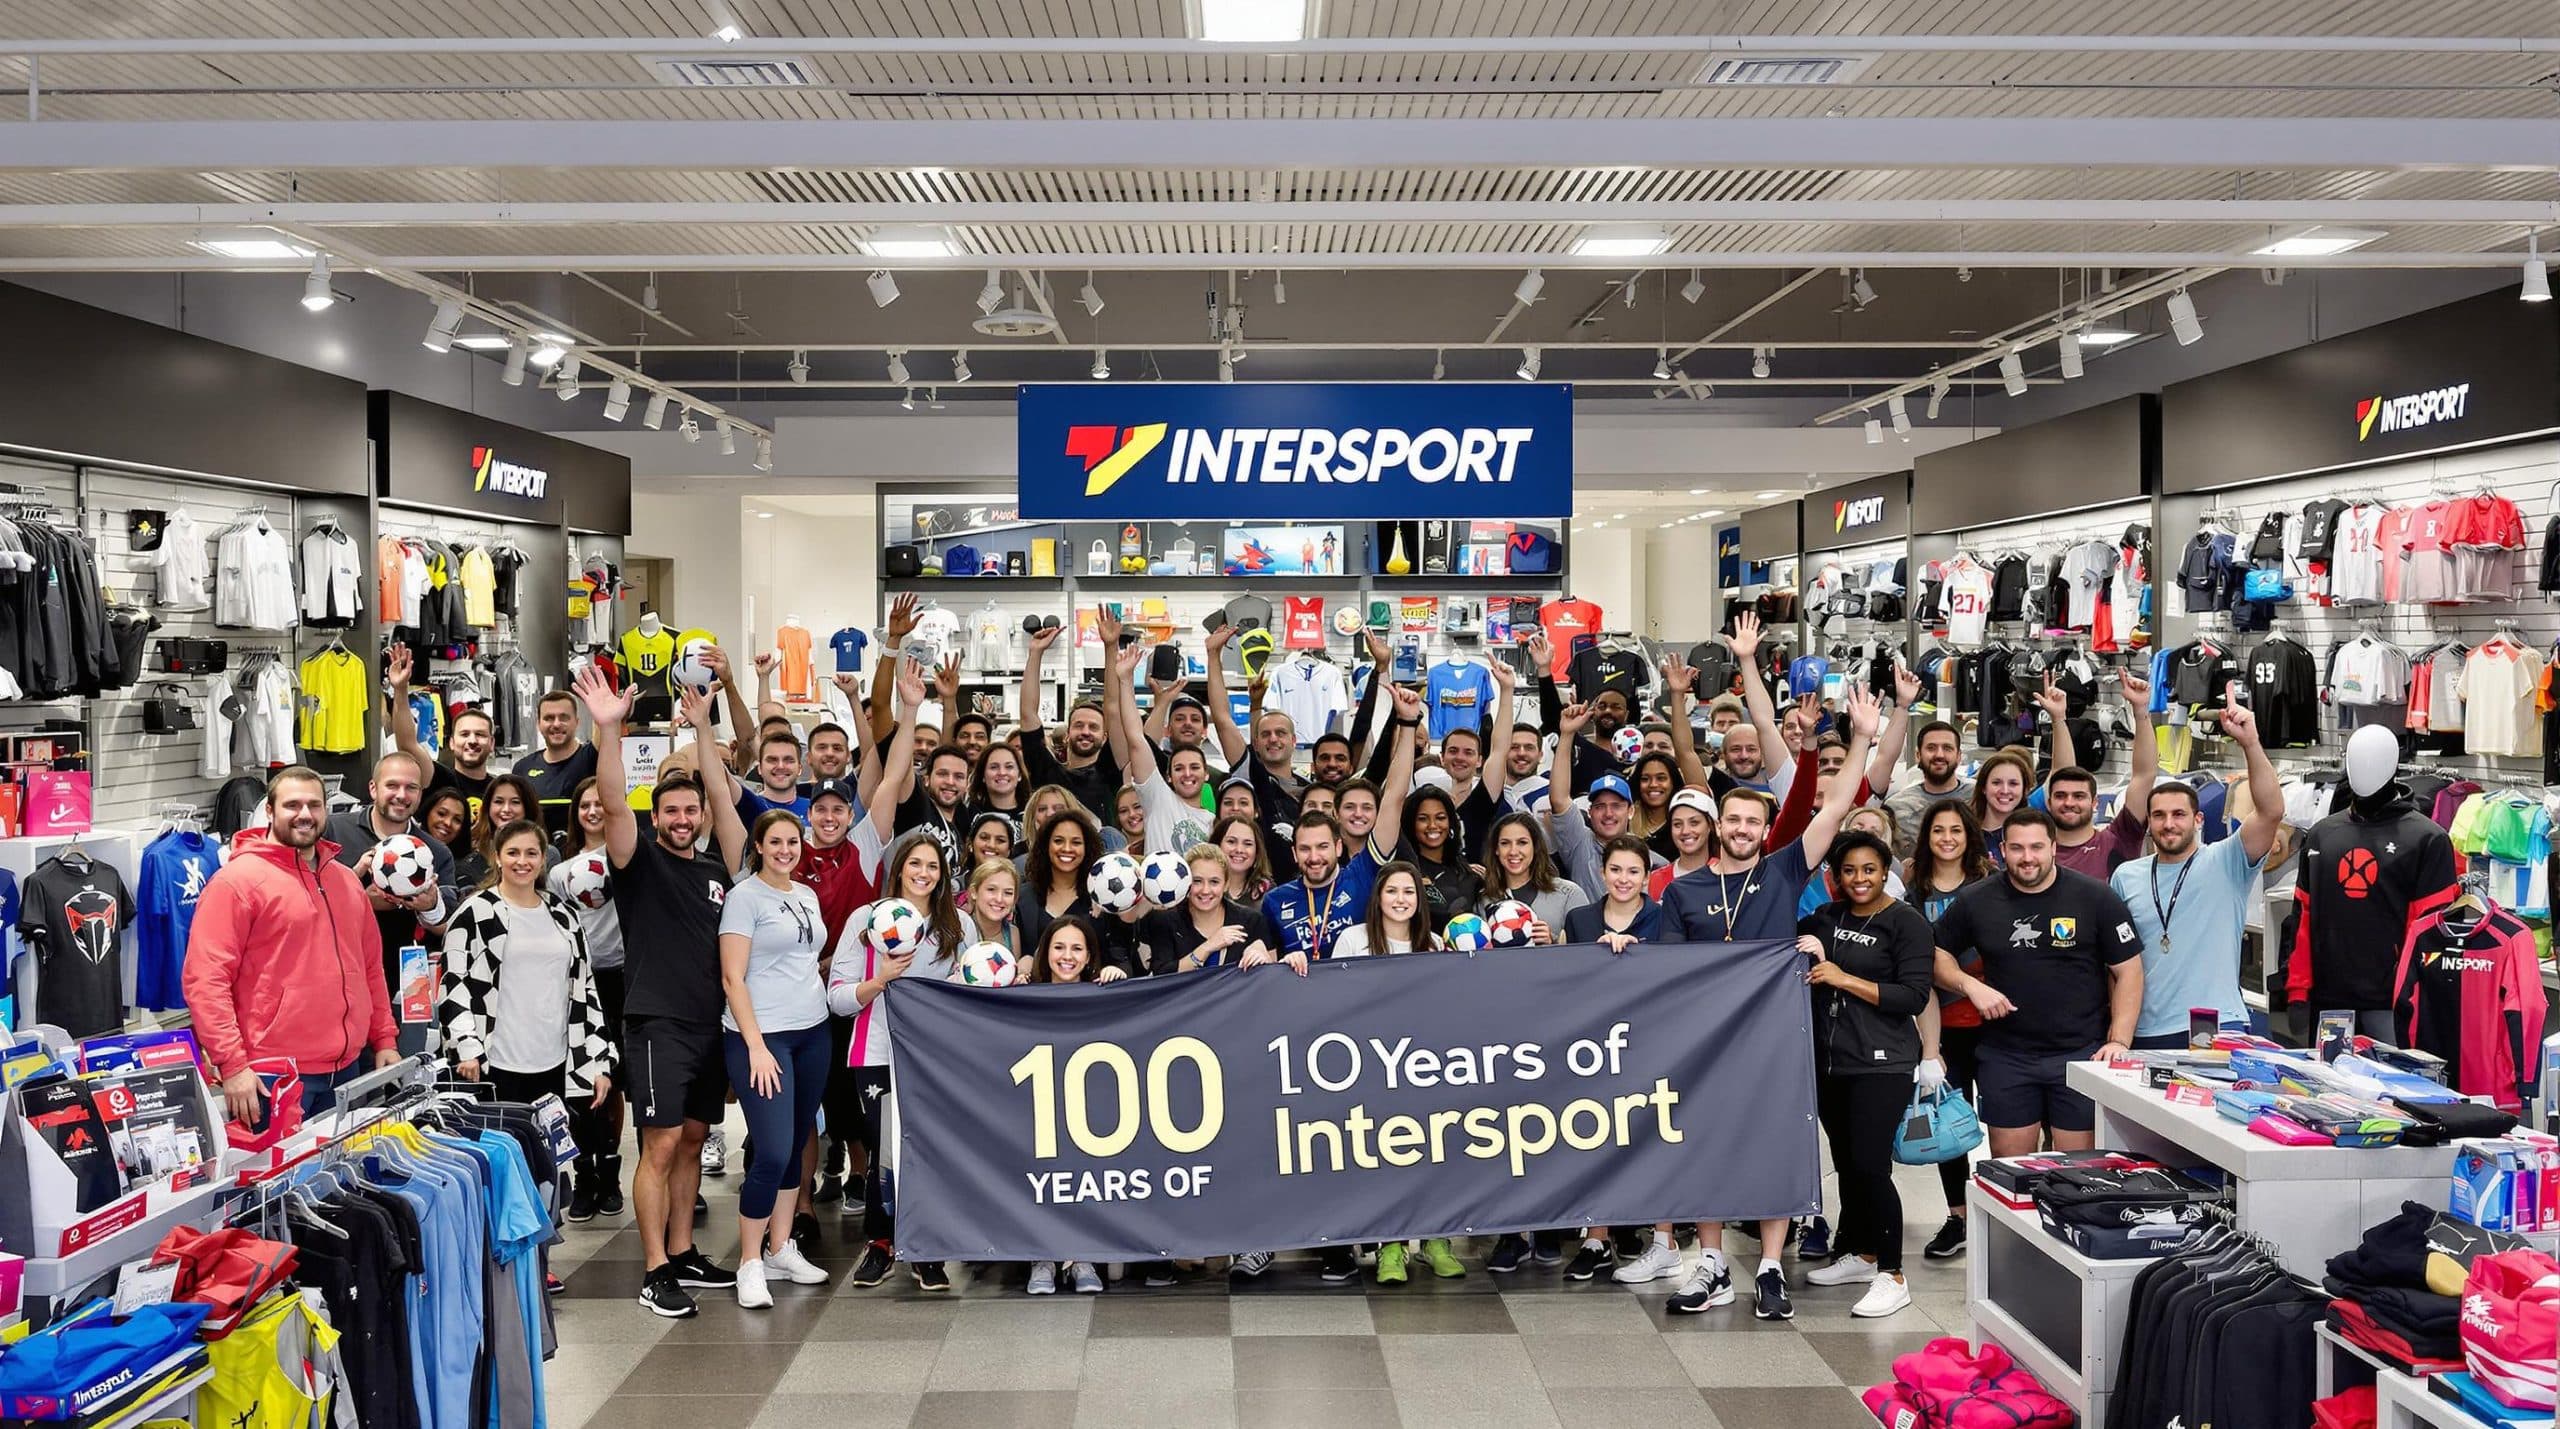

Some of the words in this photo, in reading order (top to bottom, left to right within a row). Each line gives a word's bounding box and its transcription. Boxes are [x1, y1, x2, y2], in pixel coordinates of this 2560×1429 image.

[2380, 383, 2470, 434] INTERSPORT
[1167, 427, 1534, 484] INTERSPORT
[2255, 662, 2276, 684] 93
[1566, 1022, 1631, 1077] of
[1008, 1035, 1225, 1160] 100
[1274, 1077, 1685, 1178] Intersport
[1026, 1168, 1152, 1204] YEARS
[1163, 1165, 1213, 1198] OF
